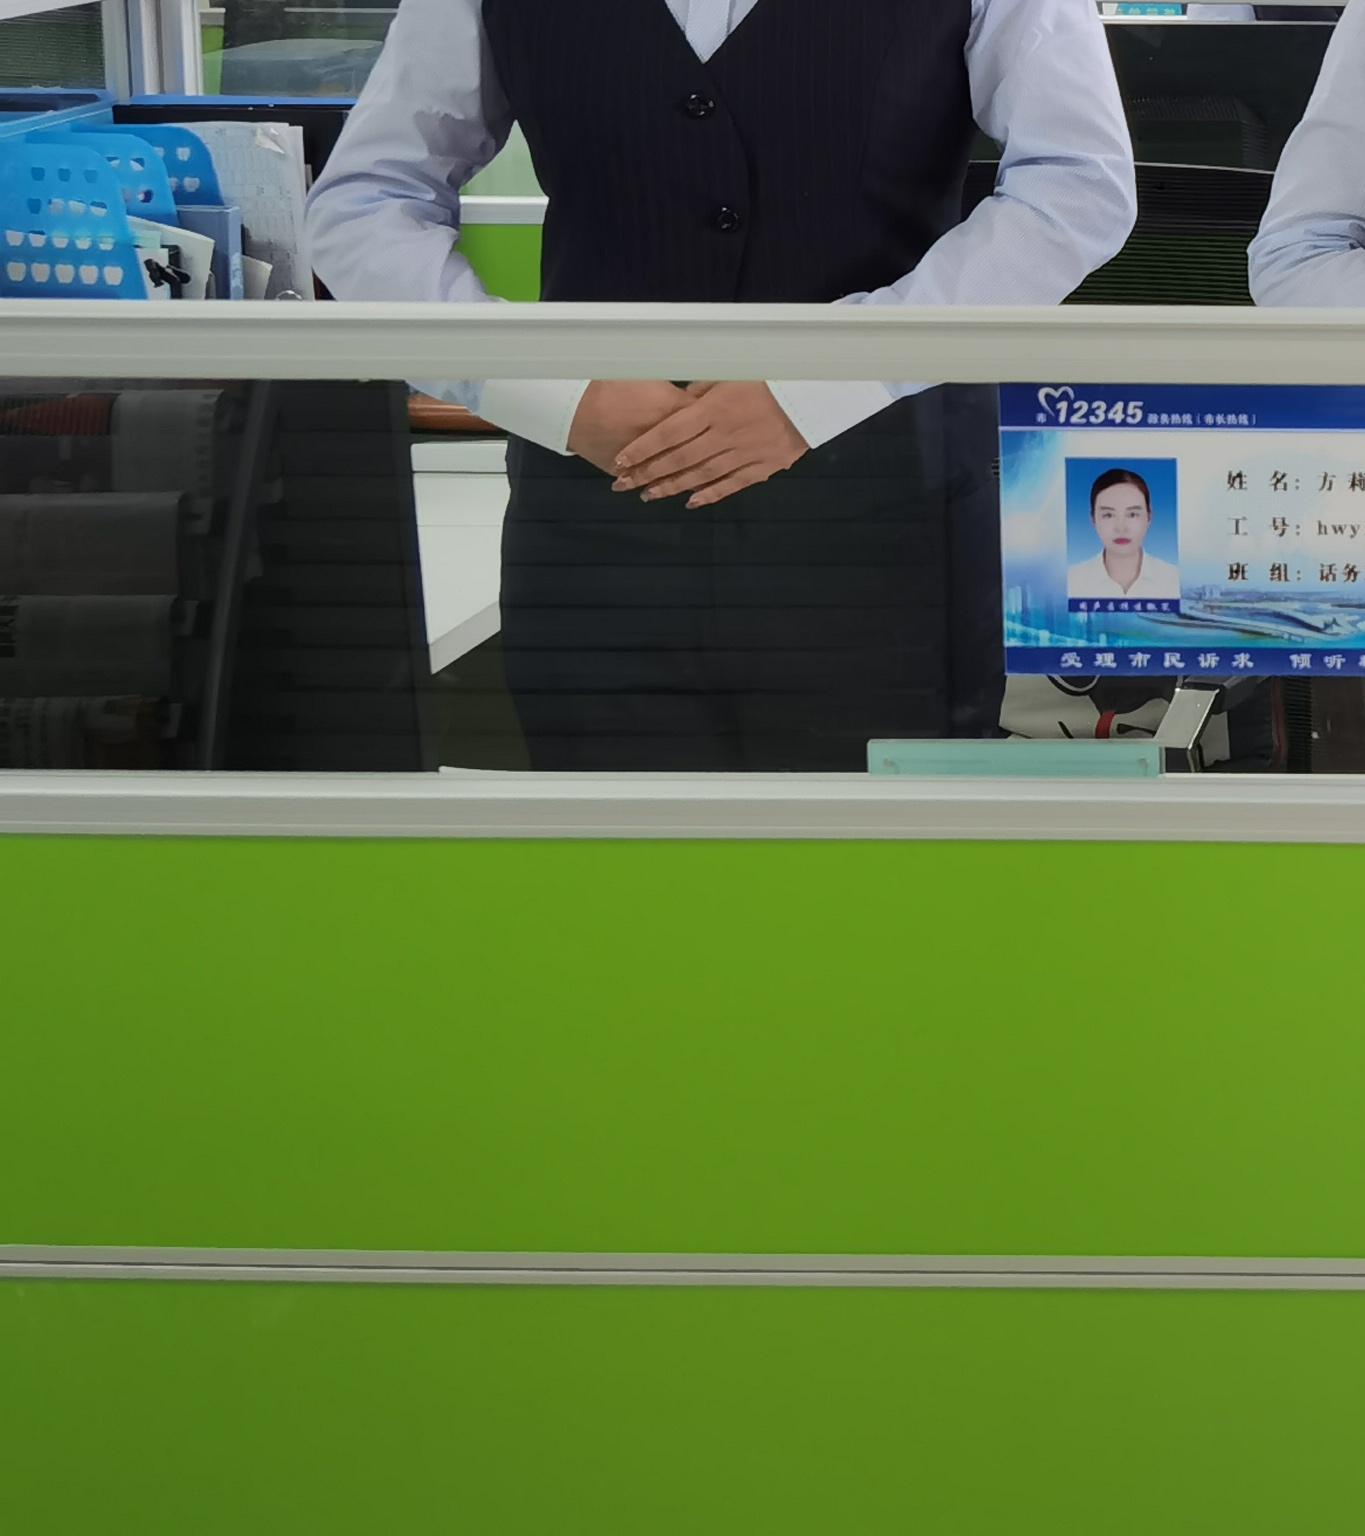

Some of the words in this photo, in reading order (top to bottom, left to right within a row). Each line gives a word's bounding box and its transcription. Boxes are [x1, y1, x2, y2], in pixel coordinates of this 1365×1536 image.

[1055, 400, 1144, 425] 12345
[1060, 652, 1255, 669] 受理市民诉求
